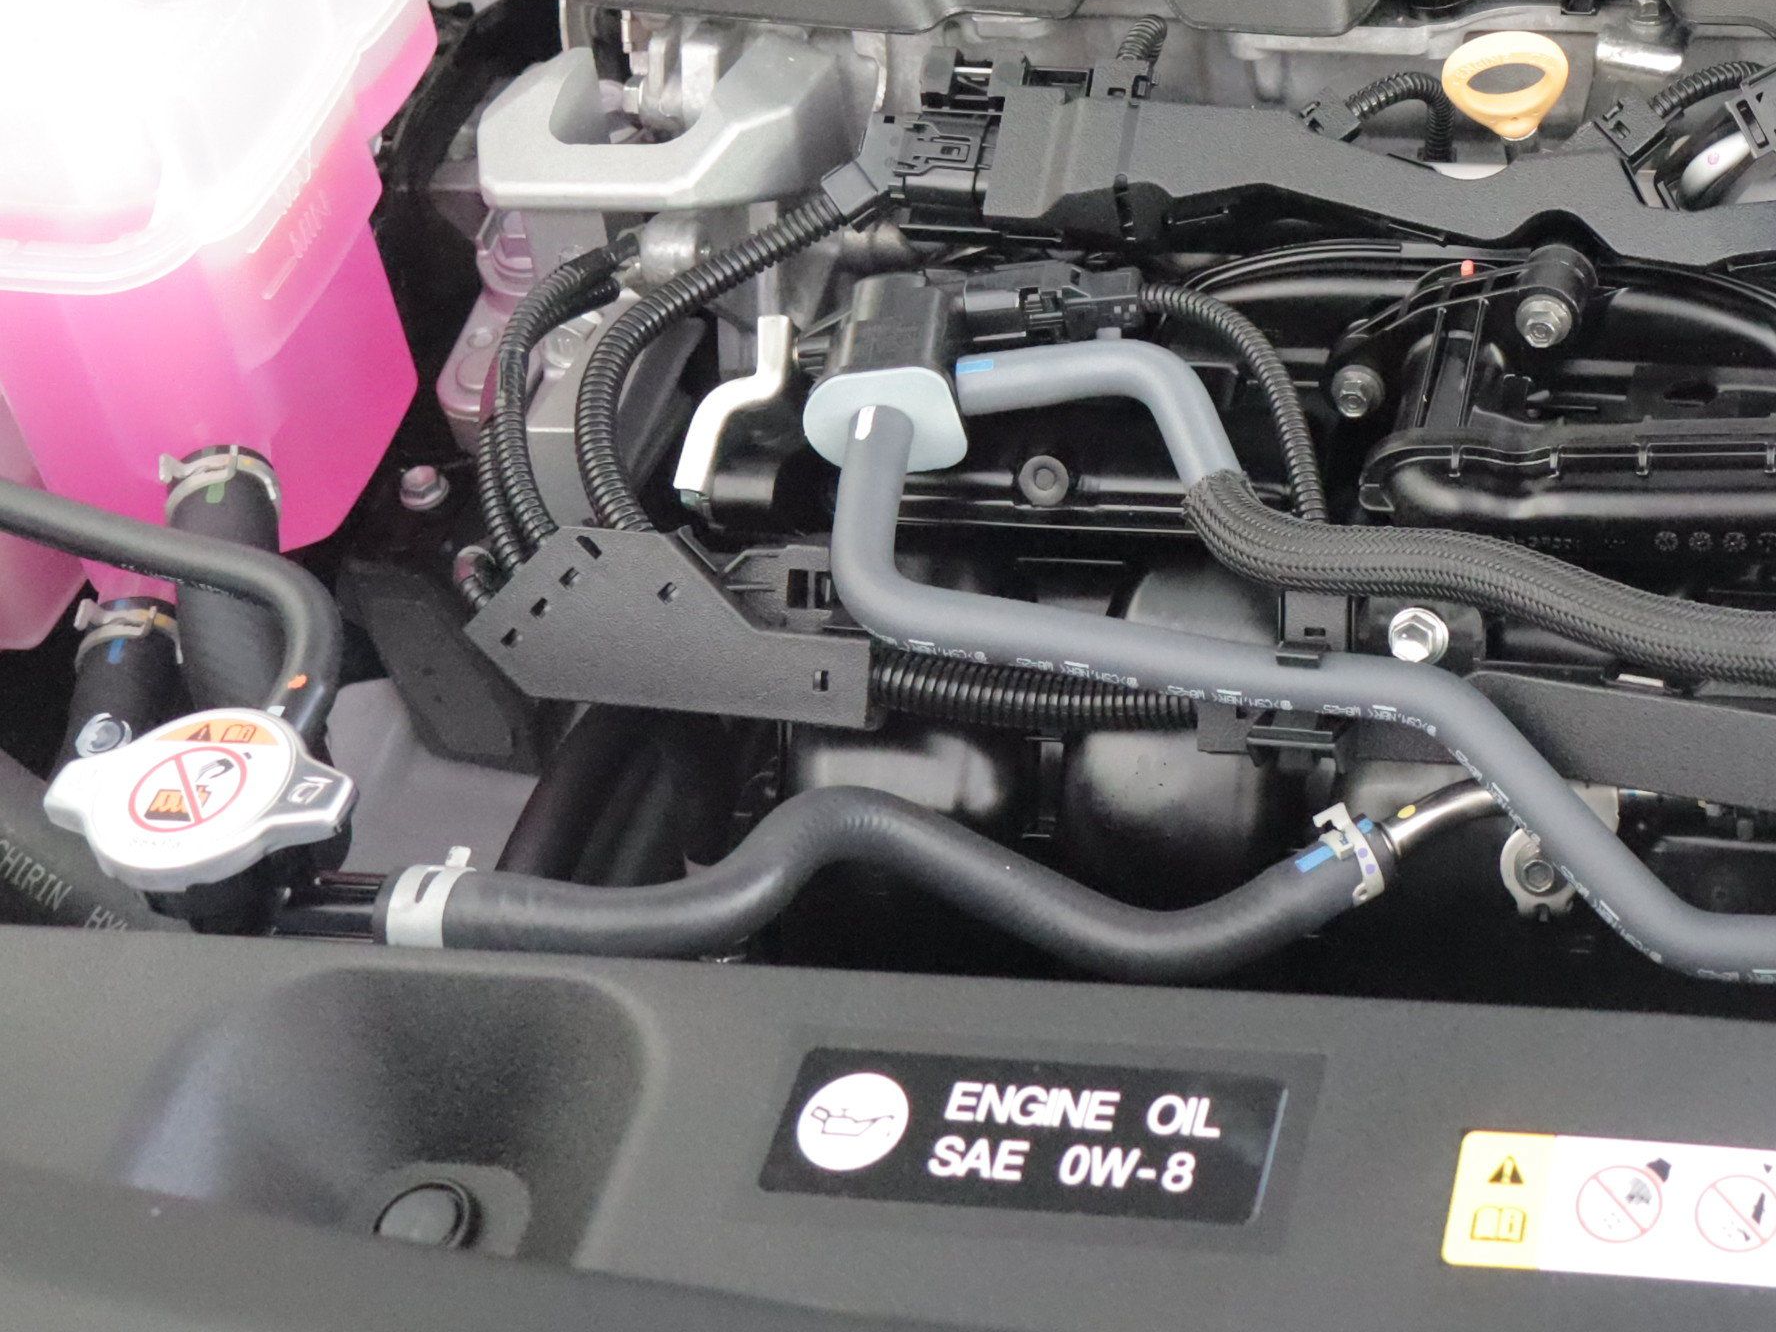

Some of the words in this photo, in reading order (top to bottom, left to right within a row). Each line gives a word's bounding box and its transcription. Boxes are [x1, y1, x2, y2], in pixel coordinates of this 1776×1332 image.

[0, 839, 73, 912] HIRIN
[944, 1081, 1120, 1131] ENGINE
[1146, 1094, 1221, 1139] OIL
[927, 1135, 1030, 1182] SAE
[1058, 1144, 1196, 1194] 0W-8
